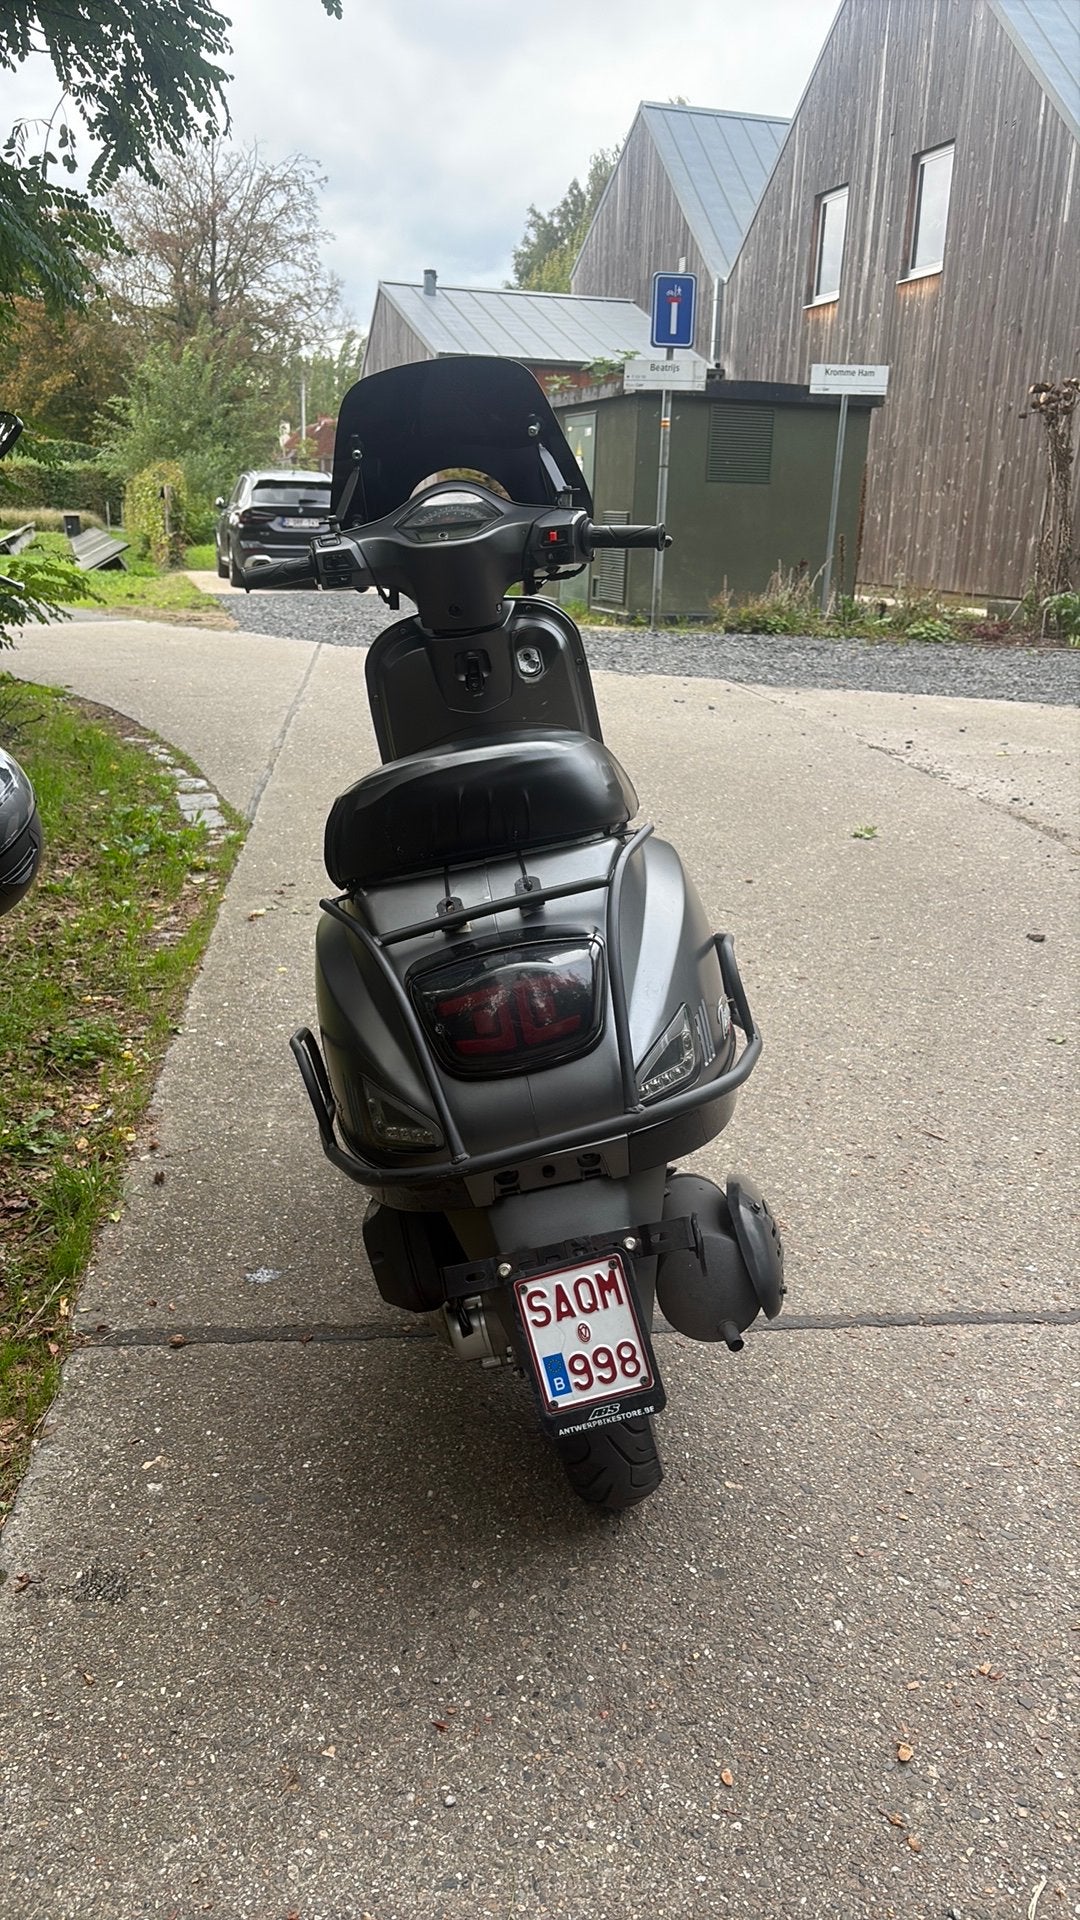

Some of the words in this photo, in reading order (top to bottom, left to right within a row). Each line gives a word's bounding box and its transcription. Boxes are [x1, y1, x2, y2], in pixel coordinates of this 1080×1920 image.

[649, 363, 680, 373] Beatrijs
[824, 367, 856, 376] Kromme
[857, 368, 875, 377] Ham
[526, 1269, 624, 1328] SAQM
[553, 1376, 566, 1391] B
[568, 1341, 641, 1391] 998
[558, 1405, 655, 1436] ANTWERPBIKESTORE.BE
